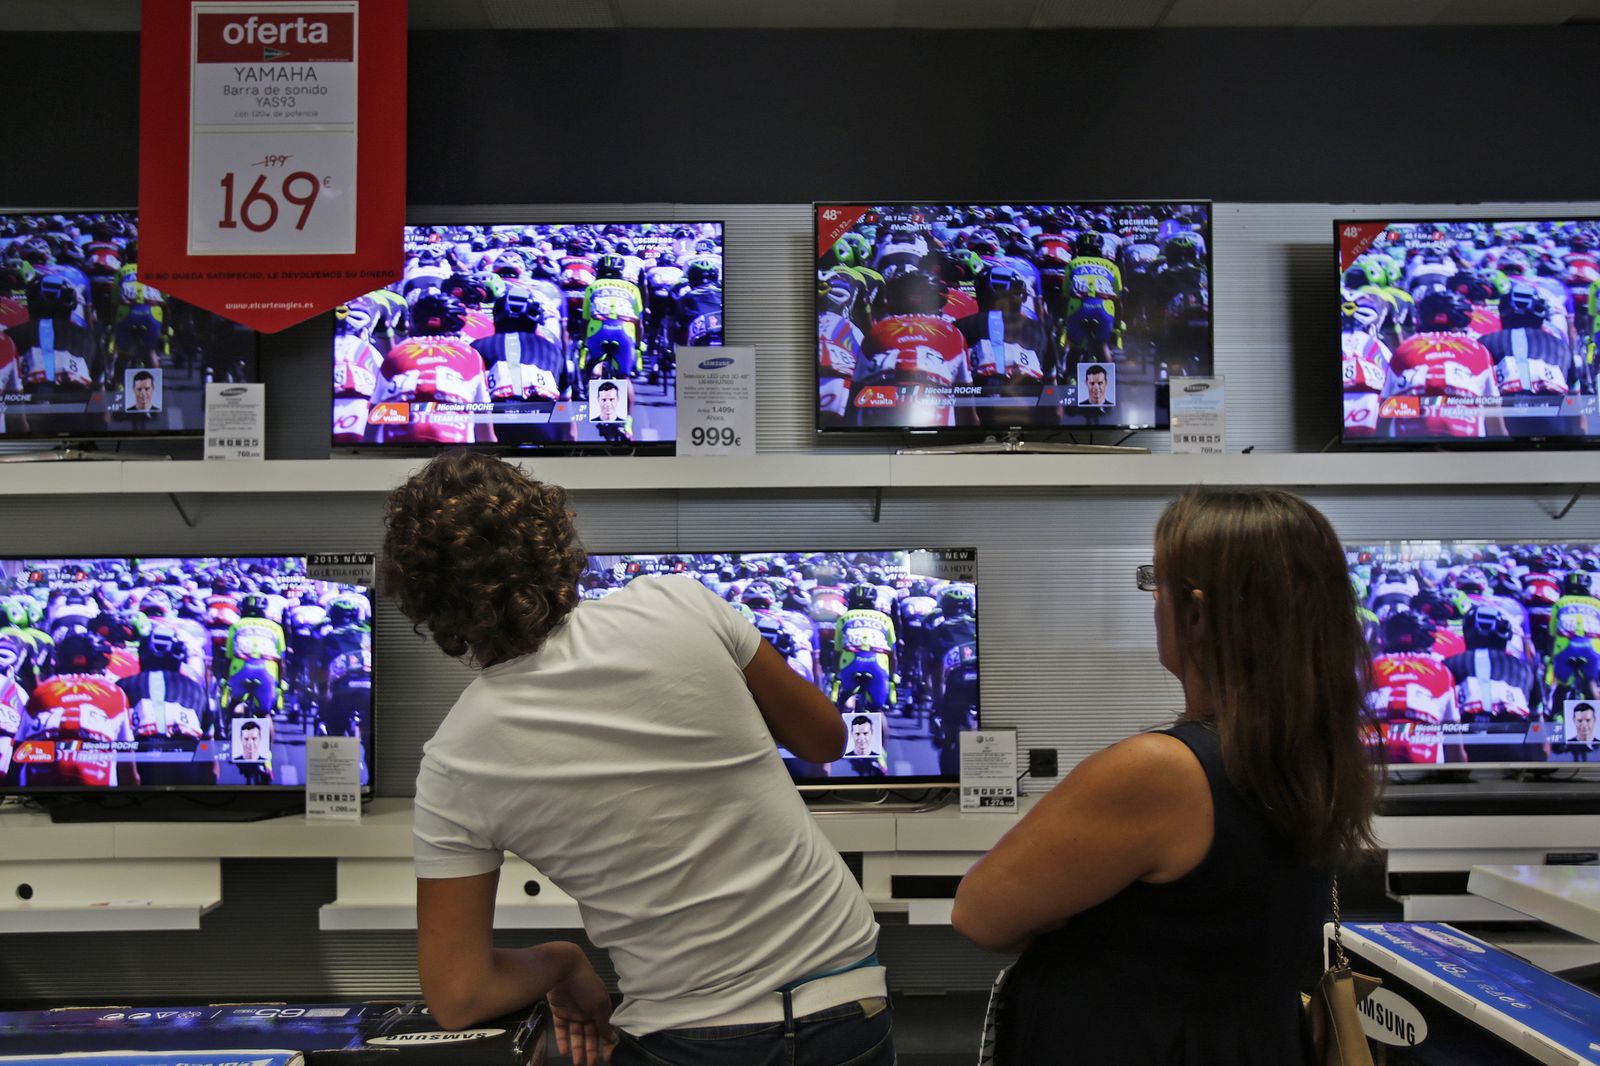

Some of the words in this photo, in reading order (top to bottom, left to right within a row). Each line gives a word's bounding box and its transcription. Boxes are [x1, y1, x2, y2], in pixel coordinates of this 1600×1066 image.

[223, 16, 328, 45] oferta
[234, 67, 318, 82] YAMAHA
[223, 85, 259, 96] Barra
[264, 85, 280, 96] de
[285, 85, 328, 95] sonido
[255, 97, 296, 108] YAS93
[264, 155, 287, 167] 199
[1166, 222, 1173, 234] 1
[680, 241, 687, 252] 1
[225, 302, 314, 311] www.elcorteingles.es
[1020, 353, 1029, 366] 8
[953, 386, 983, 394] ROCHE
[436, 403, 465, 411] Nicolas
[466, 403, 494, 411] ROCHE
[691, 427, 741, 447] 999€
[314, 556, 339, 564] 2015
[343, 555, 367, 563] NEW
[950, 564, 973, 573] HDTV
[82, 742, 111, 750] Nicolas
[111, 742, 139, 750] ROCHE
[1356, 998, 1416, 1047] AMSUNG
[385, 1032, 488, 1041] SAMSUNG
